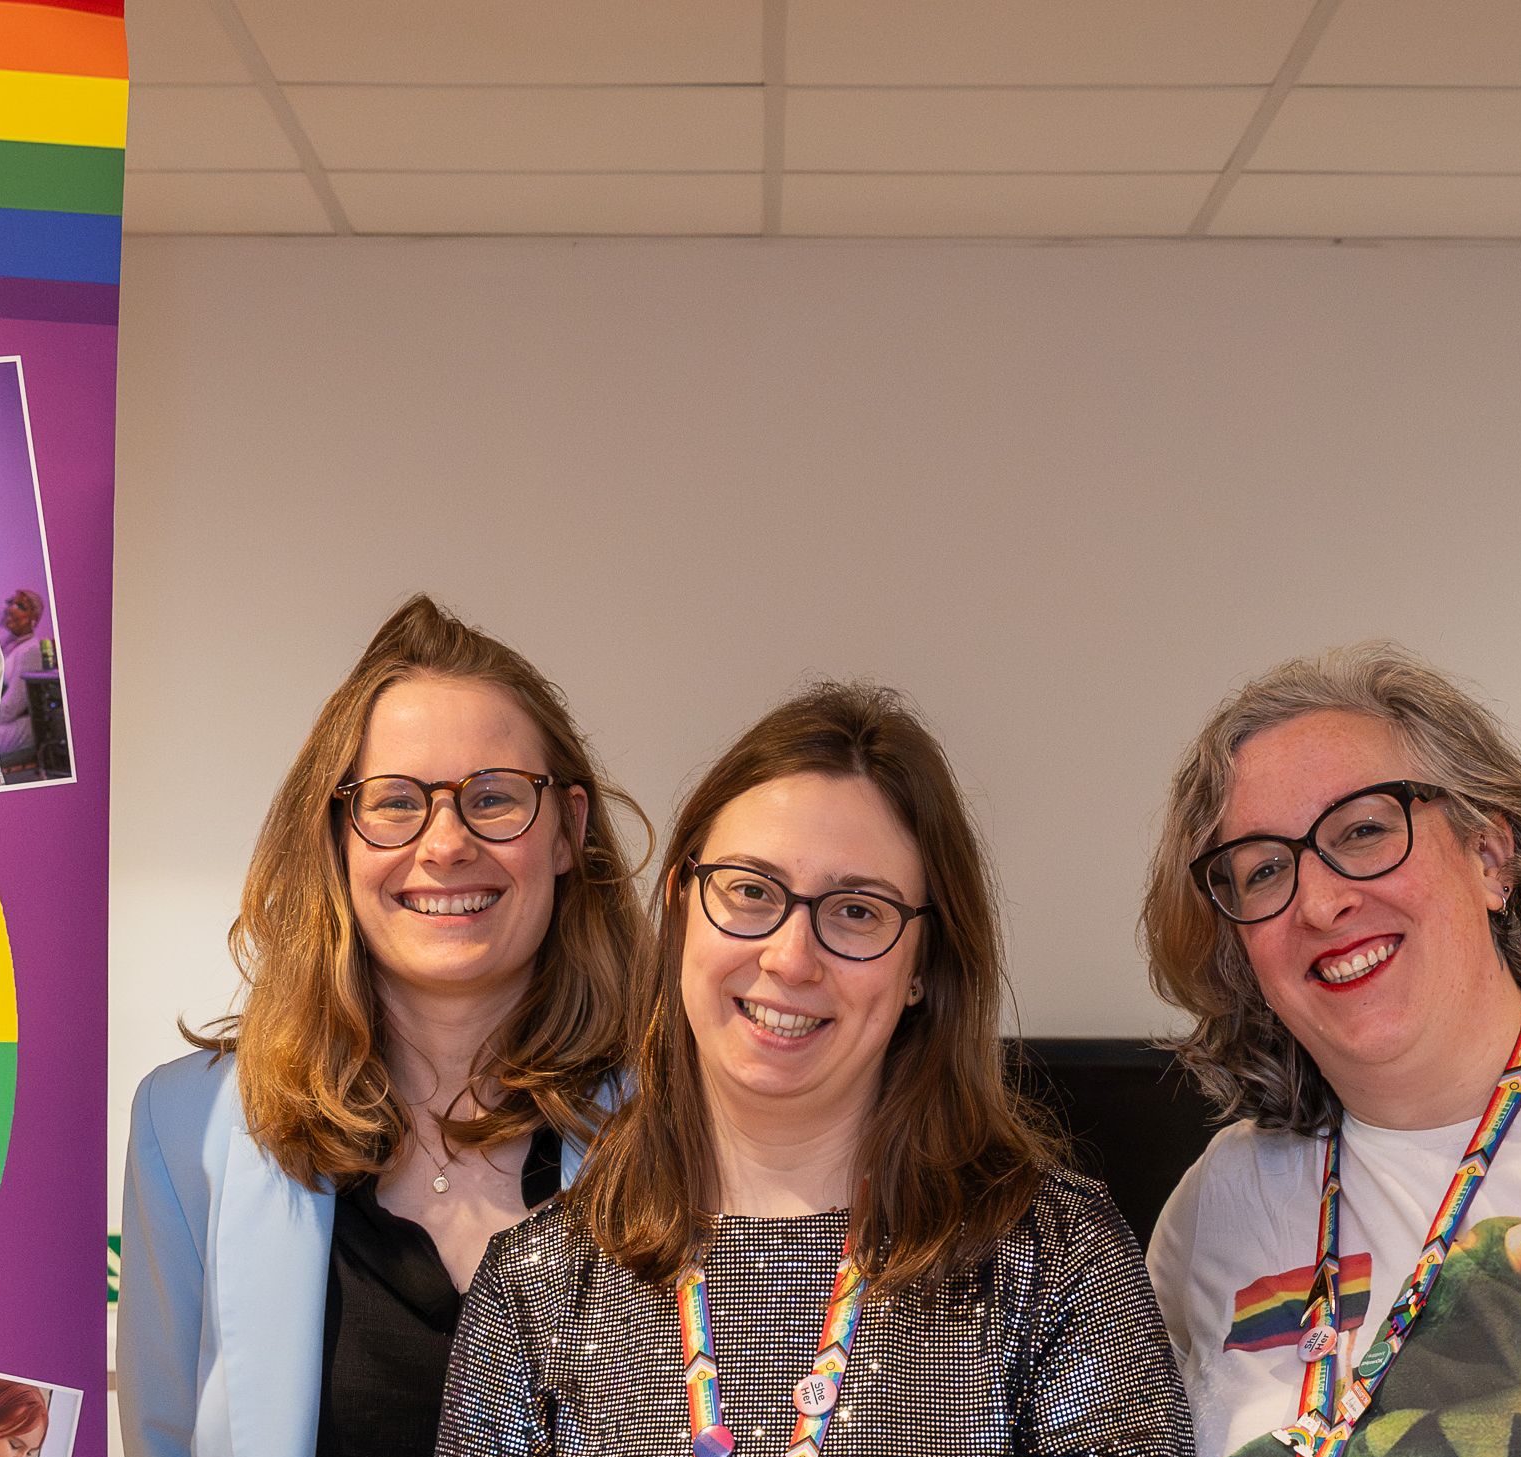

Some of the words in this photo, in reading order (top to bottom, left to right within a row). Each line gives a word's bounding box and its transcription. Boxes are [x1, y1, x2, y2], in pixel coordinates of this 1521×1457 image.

[1305, 1331, 1319, 1349] She
[1315, 1333, 1329, 1350] Her
[800, 1386, 812, 1406] Her
[814, 1382, 826, 1402] She
